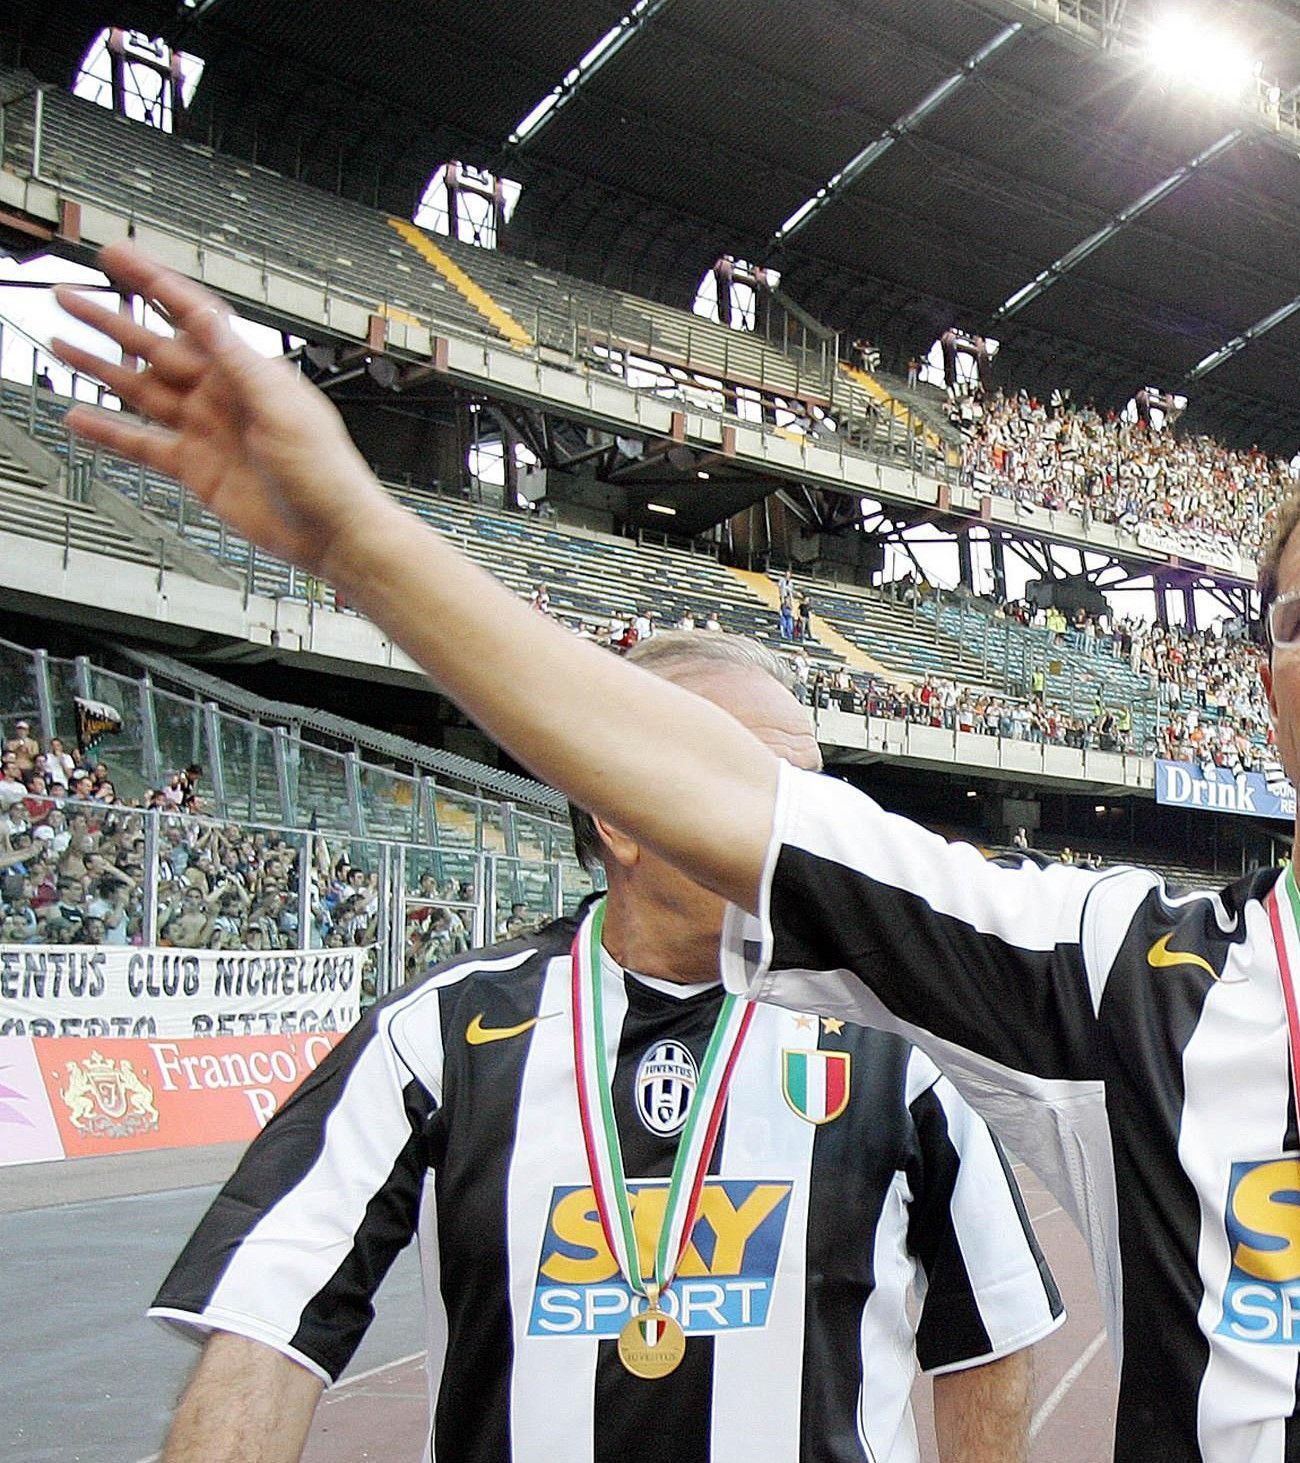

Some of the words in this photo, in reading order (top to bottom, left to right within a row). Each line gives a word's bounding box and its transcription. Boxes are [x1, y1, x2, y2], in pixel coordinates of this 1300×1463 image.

[1166, 766, 1256, 812] Drink
[0, 953, 106, 998] ENTUS
[128, 954, 200, 998] CLUB
[148, 1042, 298, 1091] Franco
[645, 1064, 693, 1078] JUVENTUS
[538, 1281, 768, 1333] SPORT
